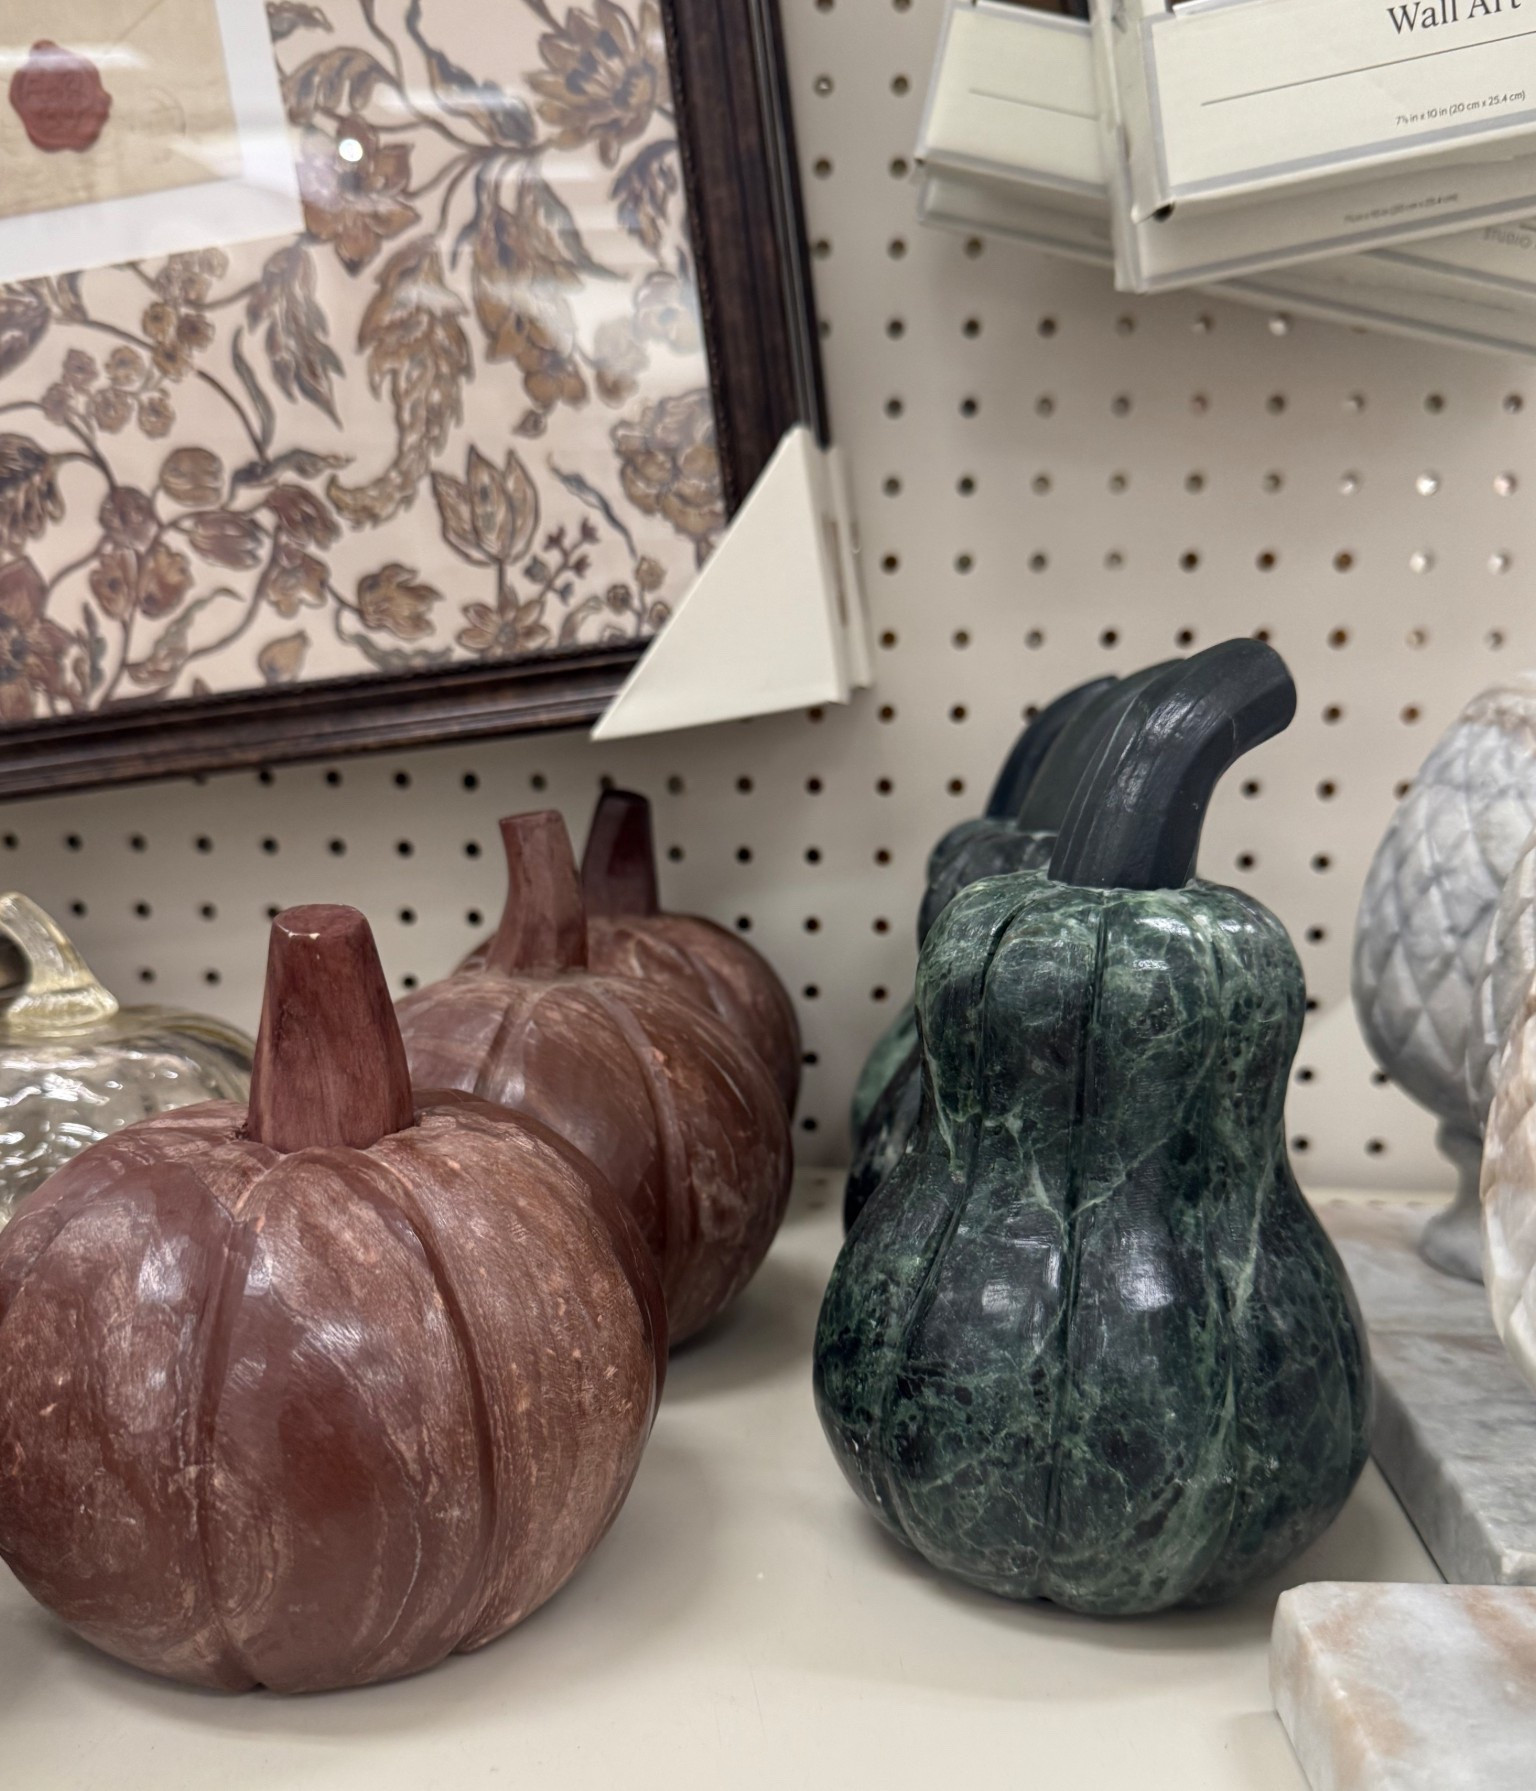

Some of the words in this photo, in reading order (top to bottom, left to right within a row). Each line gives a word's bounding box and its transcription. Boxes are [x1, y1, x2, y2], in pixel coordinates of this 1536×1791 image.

[1386, 0, 1459, 34] Wall
[1410, 113, 1418, 122] in
[1427, 108, 1438, 119] 10
[1439, 107, 1447, 116] in
[1448, 102, 1465, 116] (20
[1466, 100, 1480, 111] cm
[1481, 99, 1486, 107] x
[1487, 93, 1508, 107] 25.4
[1509, 90, 1526, 102] cm)
